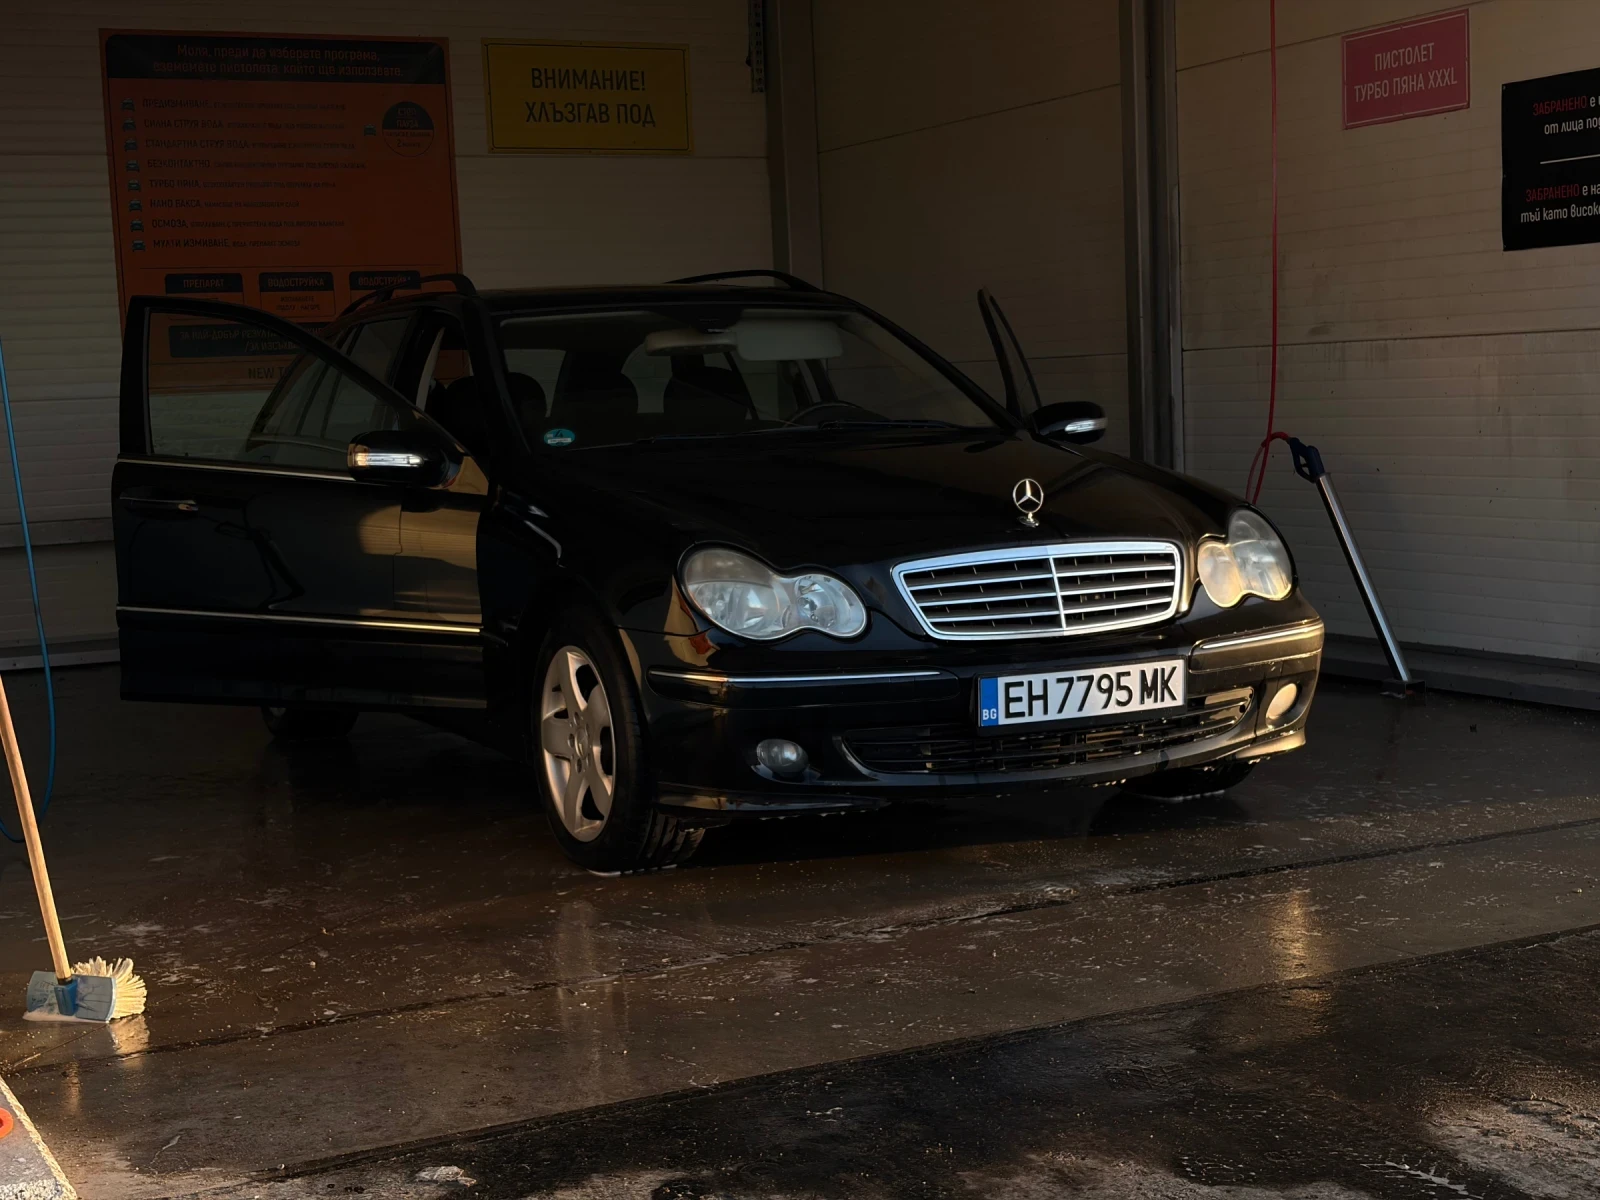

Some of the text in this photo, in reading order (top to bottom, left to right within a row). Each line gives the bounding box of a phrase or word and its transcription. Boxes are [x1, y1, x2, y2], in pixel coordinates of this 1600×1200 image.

[214, 47, 249, 59] преди
[252, 47, 266, 59] да
[325, 50, 380, 63] програма,
[1374, 42, 1434, 72] ПИСТОЛЕТ
[283, 62, 316, 74] който
[318, 65, 336, 77] ще
[531, 67, 645, 91] ВНИМАНИЕ!
[1354, 67, 1458, 103] ТУРБО ПЯНА XXXL
[1532, 95, 1588, 116] ЗАБРАНЕНО
[1590, 96, 1596, 108] е
[525, 101, 656, 128] ХЛЪЗГАВ ПОД
[174, 119, 199, 129] СТРУЯ
[1544, 123, 1559, 135] от
[1561, 119, 1583, 134] лица
[145, 139, 198, 149] СТАНДАРТНА
[200, 139, 224, 149] СТРУЯ
[149, 179, 175, 188] ТУРБО
[1525, 184, 1580, 202] ЗАБРАНЕНО
[1582, 186, 1588, 197] е
[150, 199, 173, 208] НАНО
[1520, 209, 1540, 223] тъй
[1543, 207, 1568, 221] като
[153, 240, 181, 248] МУЛТИ
[183, 278, 224, 288] ПРЕПАРАТ
[268, 276, 324, 288] ВОДОСТРУЙКА
[192, 330, 240, 341] НАЙ-ДОБЪР
[248, 367, 275, 379] NEW
[1004, 666, 1178, 719] EH 7795 MK
[982, 708, 997, 721] BG
